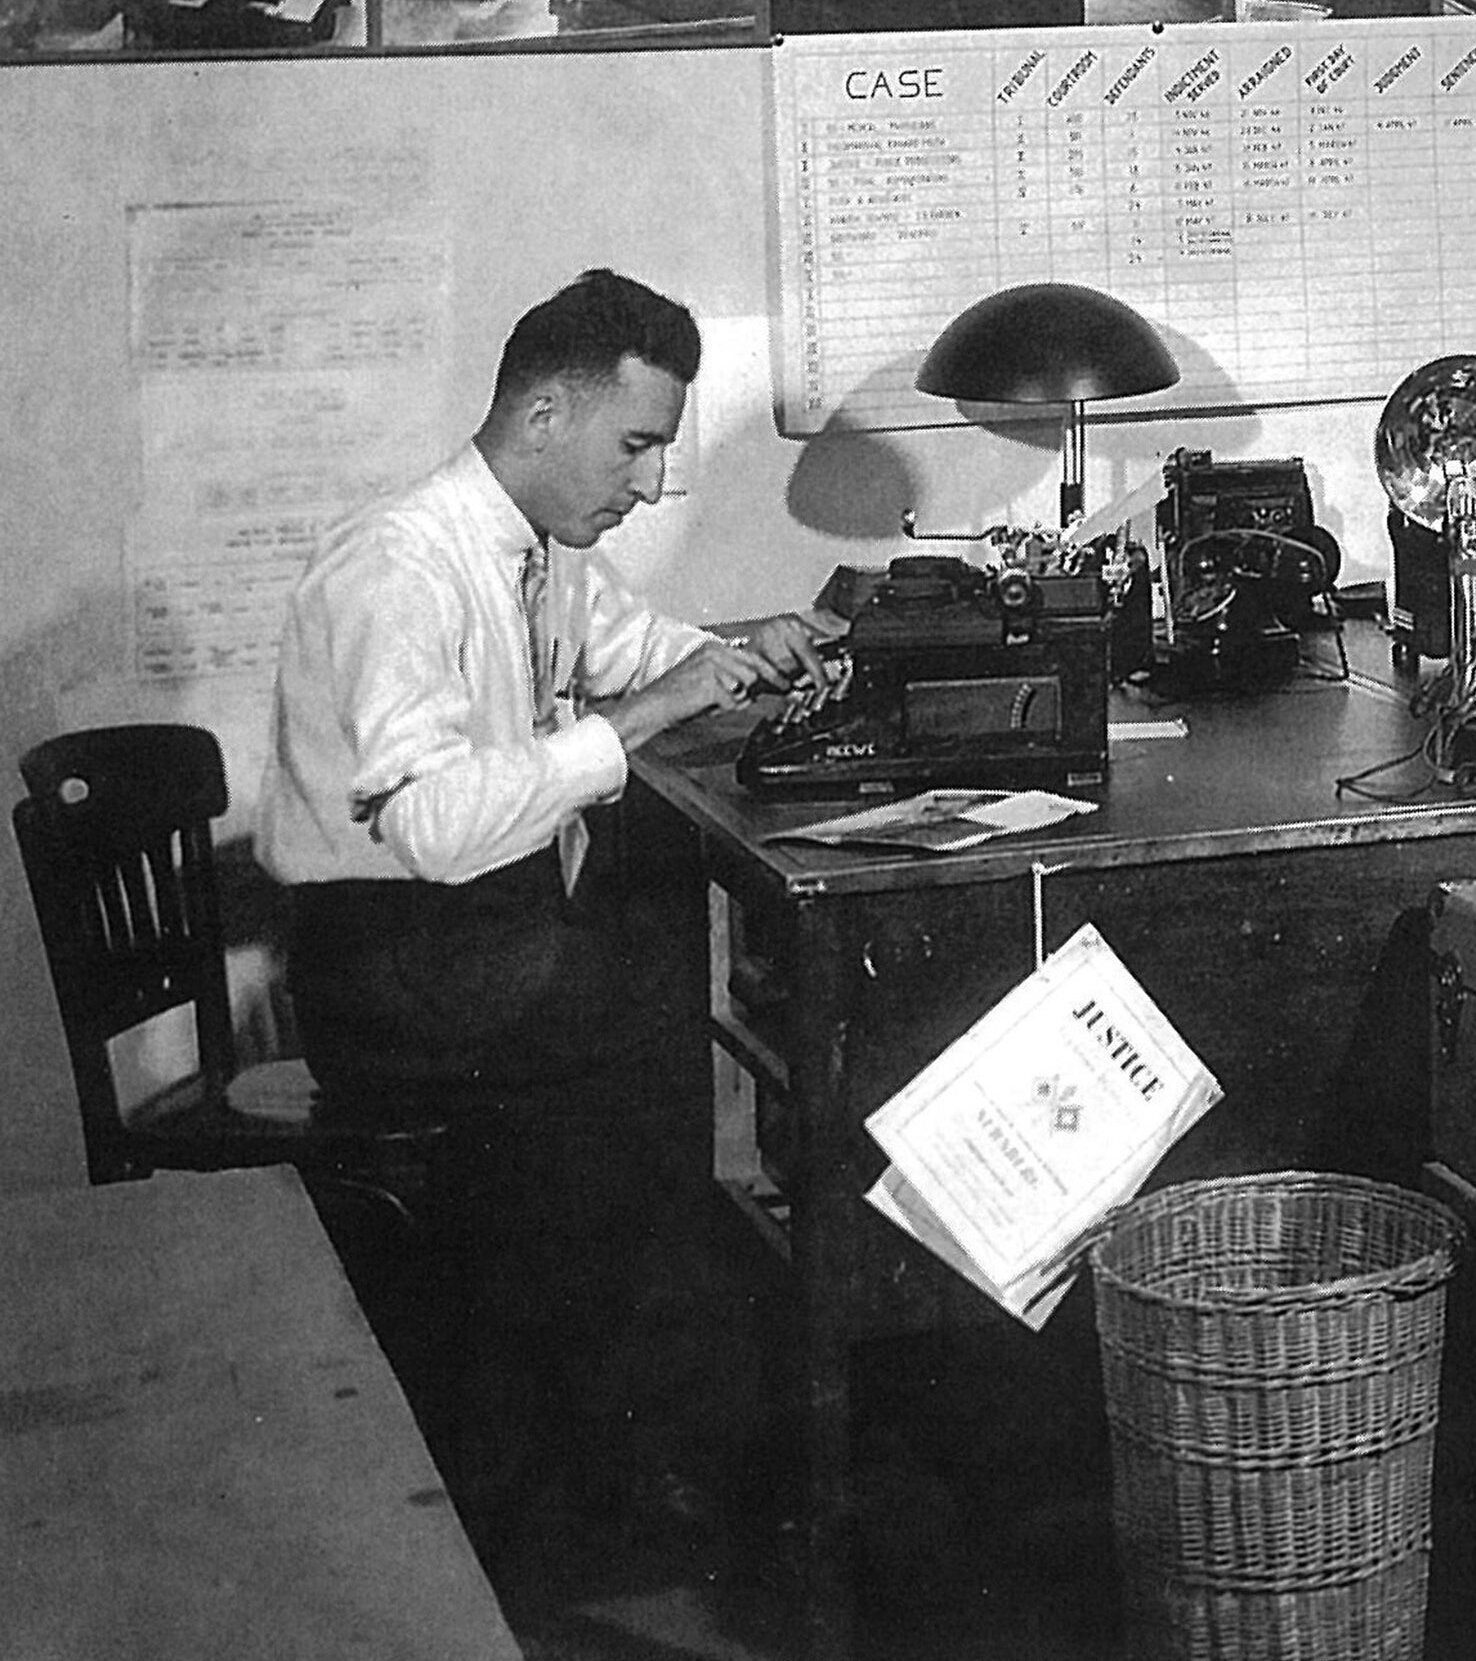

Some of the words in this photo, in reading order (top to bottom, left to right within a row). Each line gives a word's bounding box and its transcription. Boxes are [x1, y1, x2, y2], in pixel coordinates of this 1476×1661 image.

[846, 69, 943, 99] CASE
[997, 49, 1047, 104] TRIBUNAL
[1047, 50, 1098, 107] COURTROOM
[1104, 46, 1156, 105] DEFENDANTS
[1164, 49, 1220, 103] INDICTMENT
[1187, 70, 1220, 101] SERVED
[1239, 46, 1292, 99] ARRAIGNED
[1305, 60, 1329, 87] FIRST
[1327, 43, 1346, 66] DAY
[1316, 79, 1329, 94] OF
[1328, 55, 1355, 82] COURT
[1071, 999, 1164, 1101] JUSTICE
